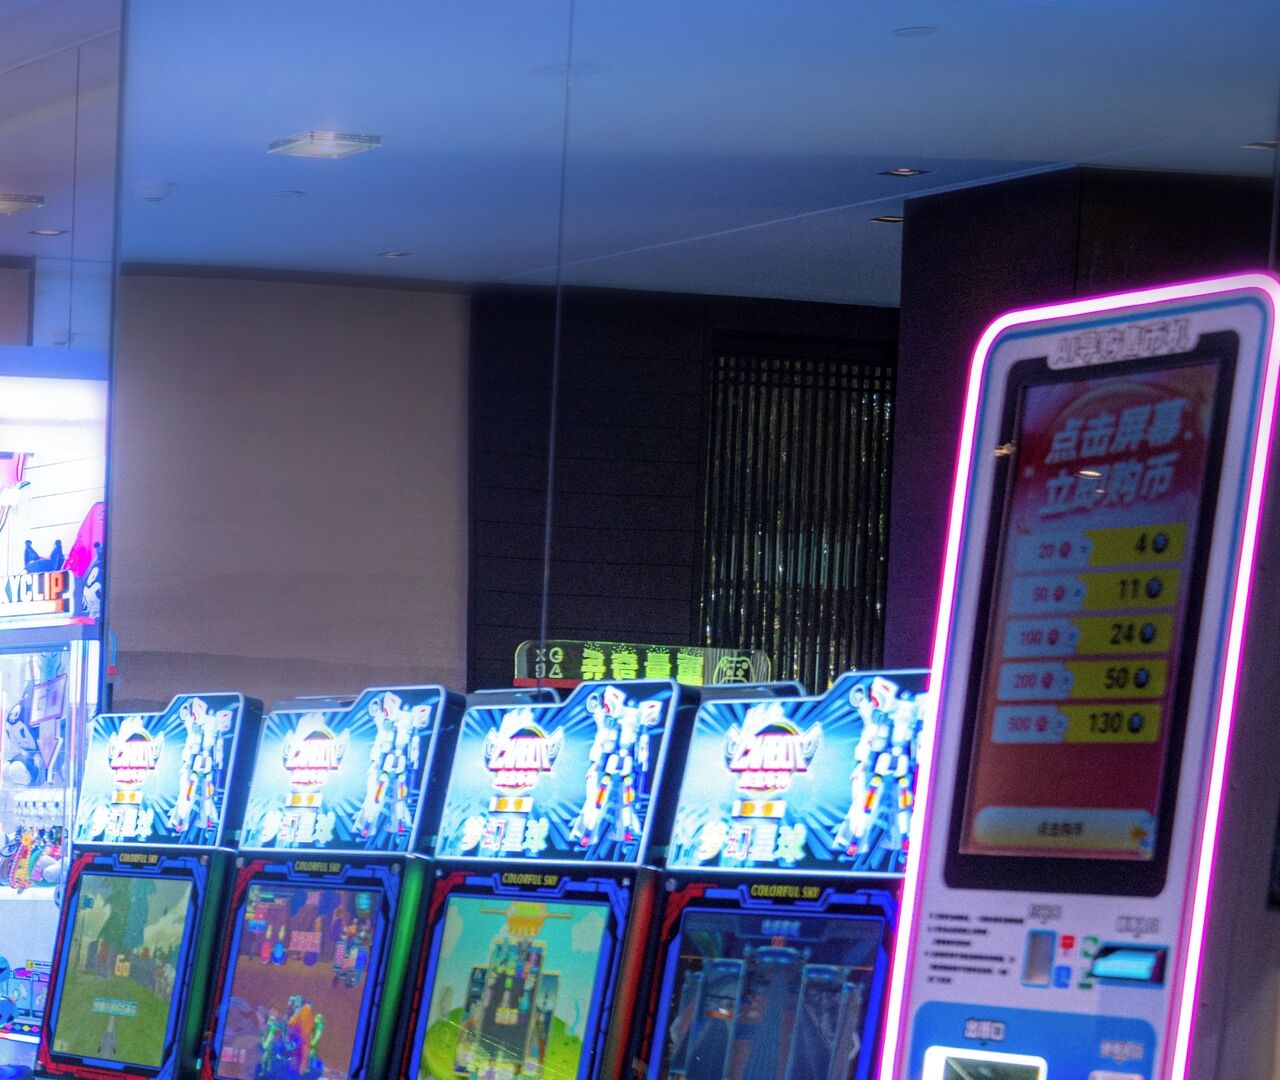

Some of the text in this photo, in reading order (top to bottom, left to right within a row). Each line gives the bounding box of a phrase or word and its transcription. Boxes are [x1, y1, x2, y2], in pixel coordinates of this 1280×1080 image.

[1044, 398, 1186, 464] 点击屏幕
[1136, 533, 1147, 553] 4
[1119, 579, 1139, 599] 11
[1110, 623, 1135, 645] 24
[1105, 667, 1128, 689] 50
[1090, 712, 1122, 734] 130
[502, 872, 558, 887] COLORFUL SKY
[750, 884, 820, 899] COLORFUL SKY
